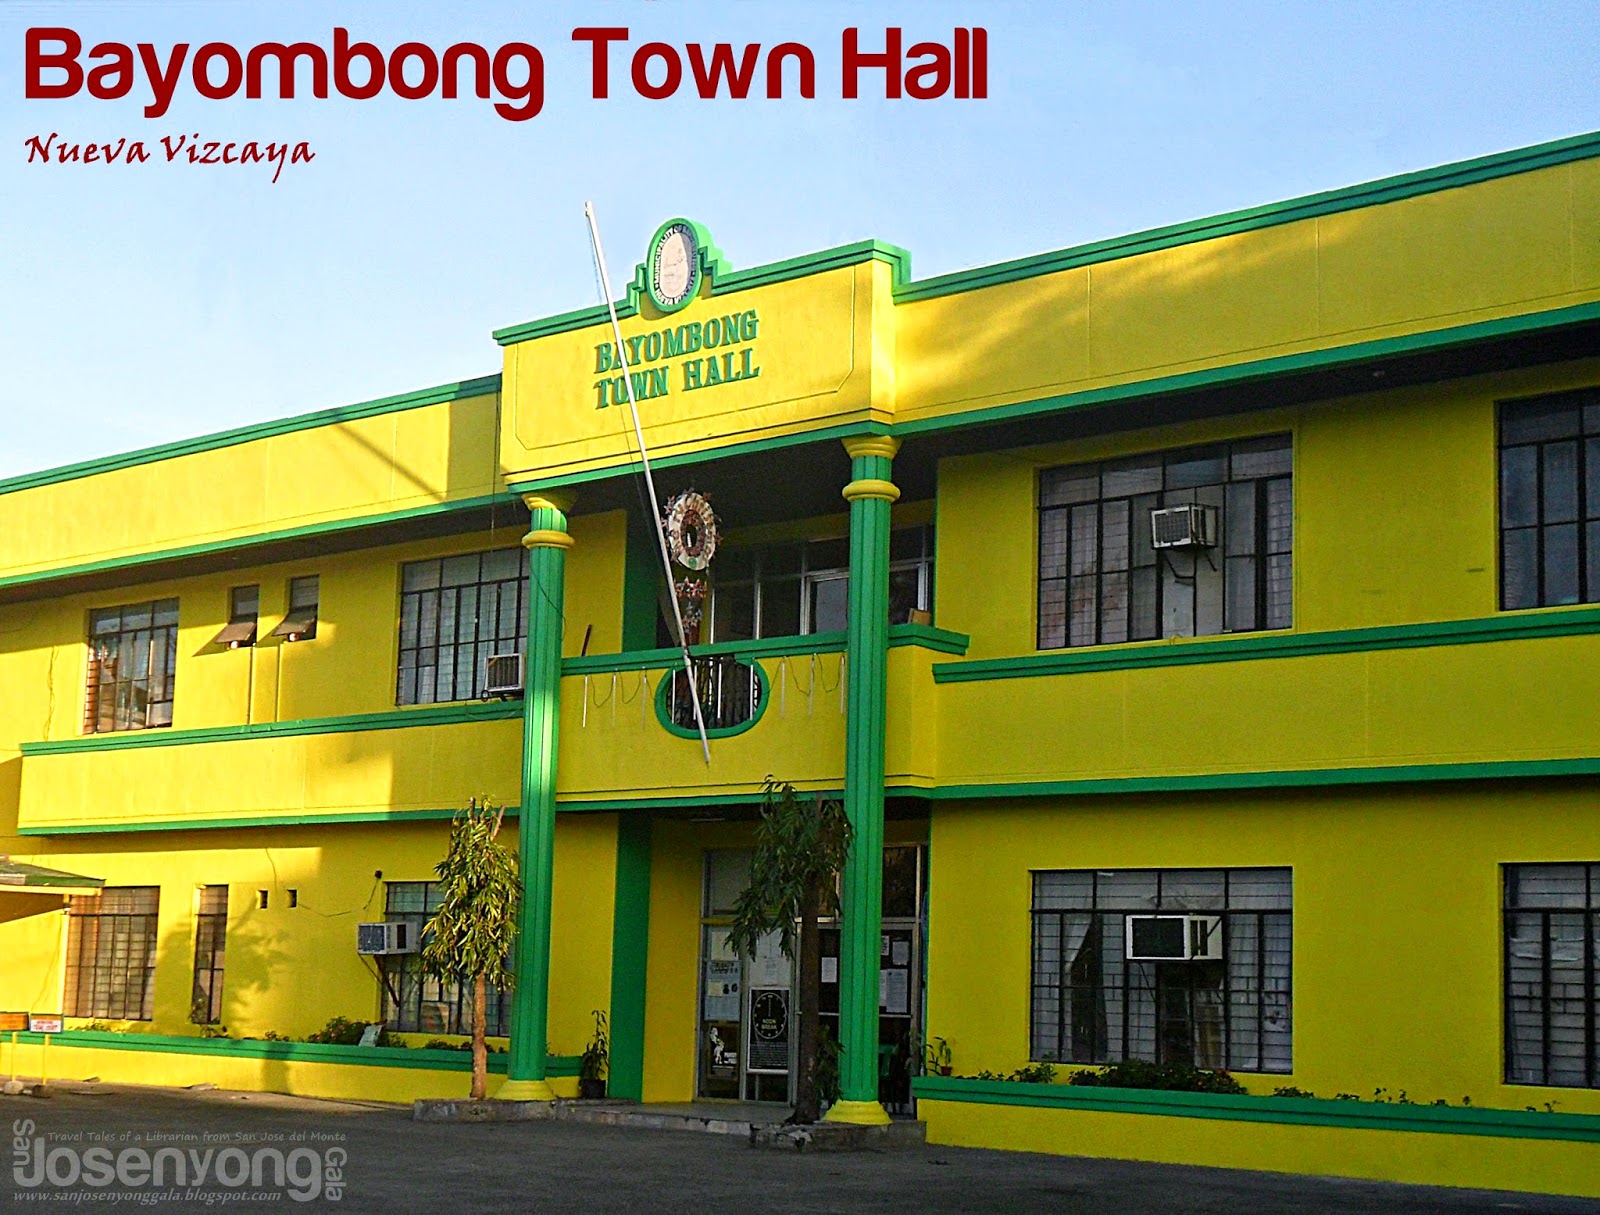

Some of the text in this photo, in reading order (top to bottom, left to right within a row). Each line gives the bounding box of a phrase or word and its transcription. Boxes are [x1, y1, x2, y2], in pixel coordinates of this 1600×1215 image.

[594, 309, 759, 374] BAYOMBONG
[593, 348, 760, 410] TOWN HALL
